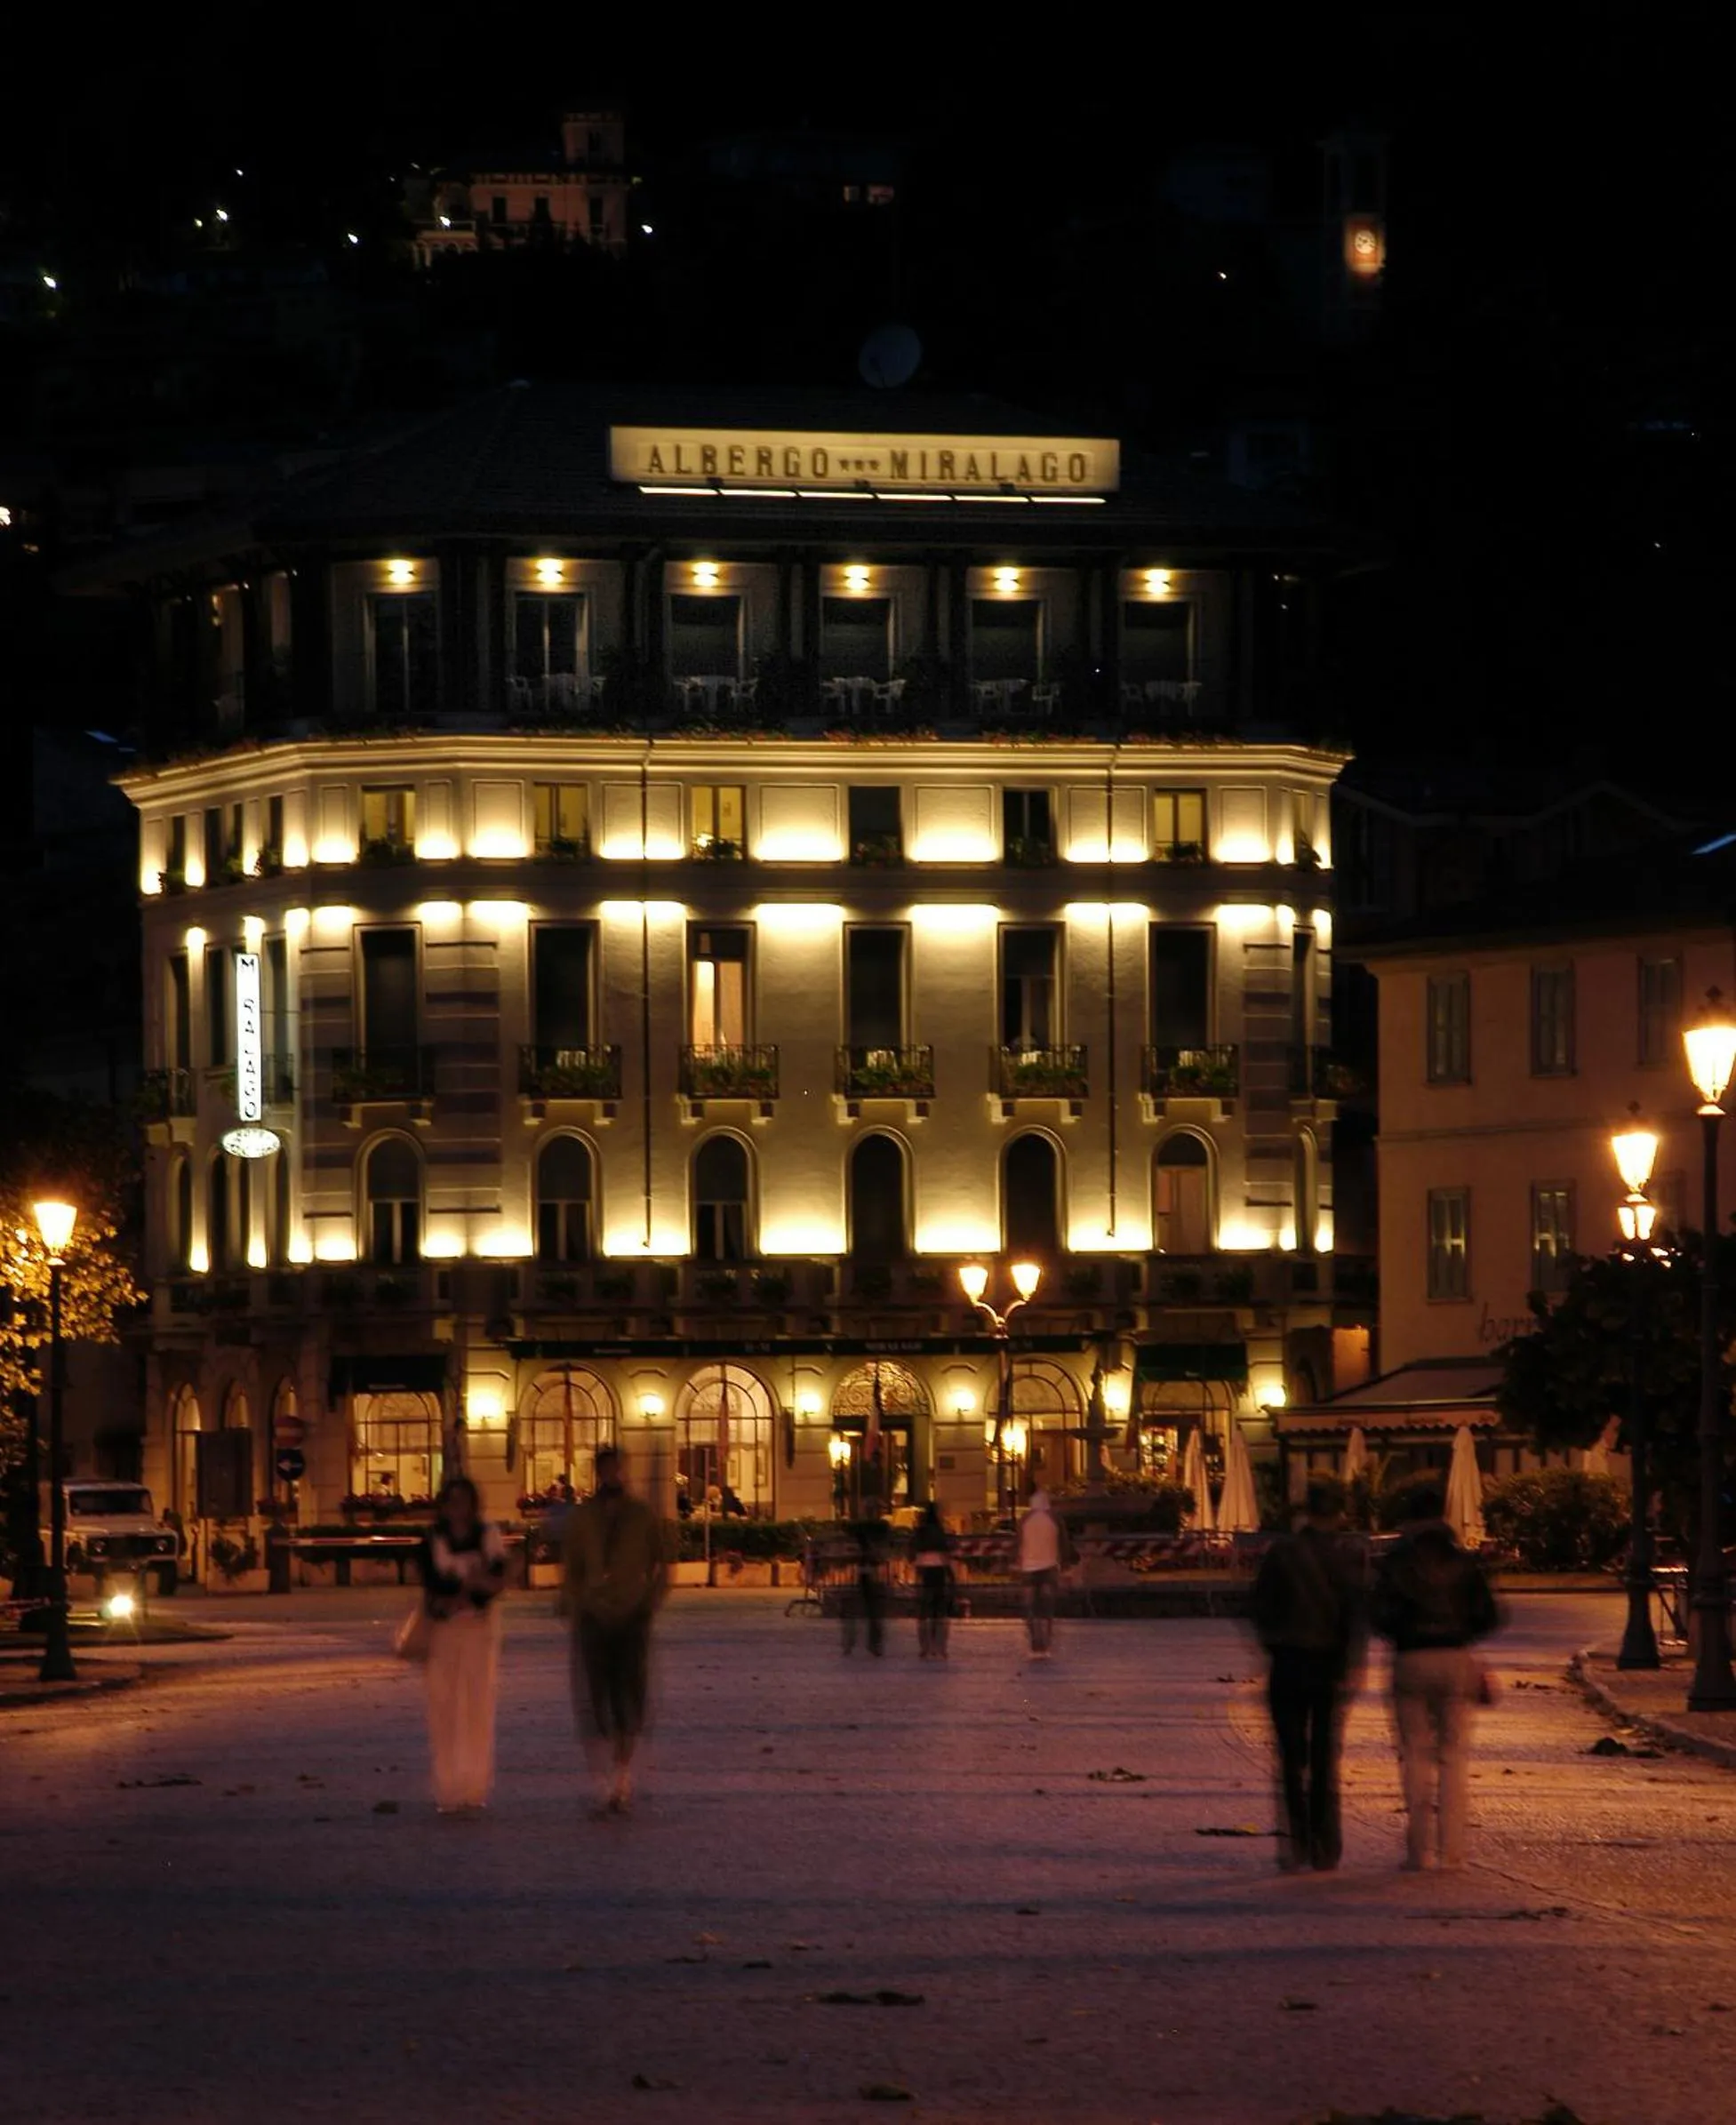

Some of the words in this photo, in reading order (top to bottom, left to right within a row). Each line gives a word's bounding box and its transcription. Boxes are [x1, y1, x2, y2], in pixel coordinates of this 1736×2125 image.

[648, 443, 828, 478] ALBERGO
[890, 449, 1086, 483] MIRALAGO
[240, 956, 258, 1119] MRALAGO
